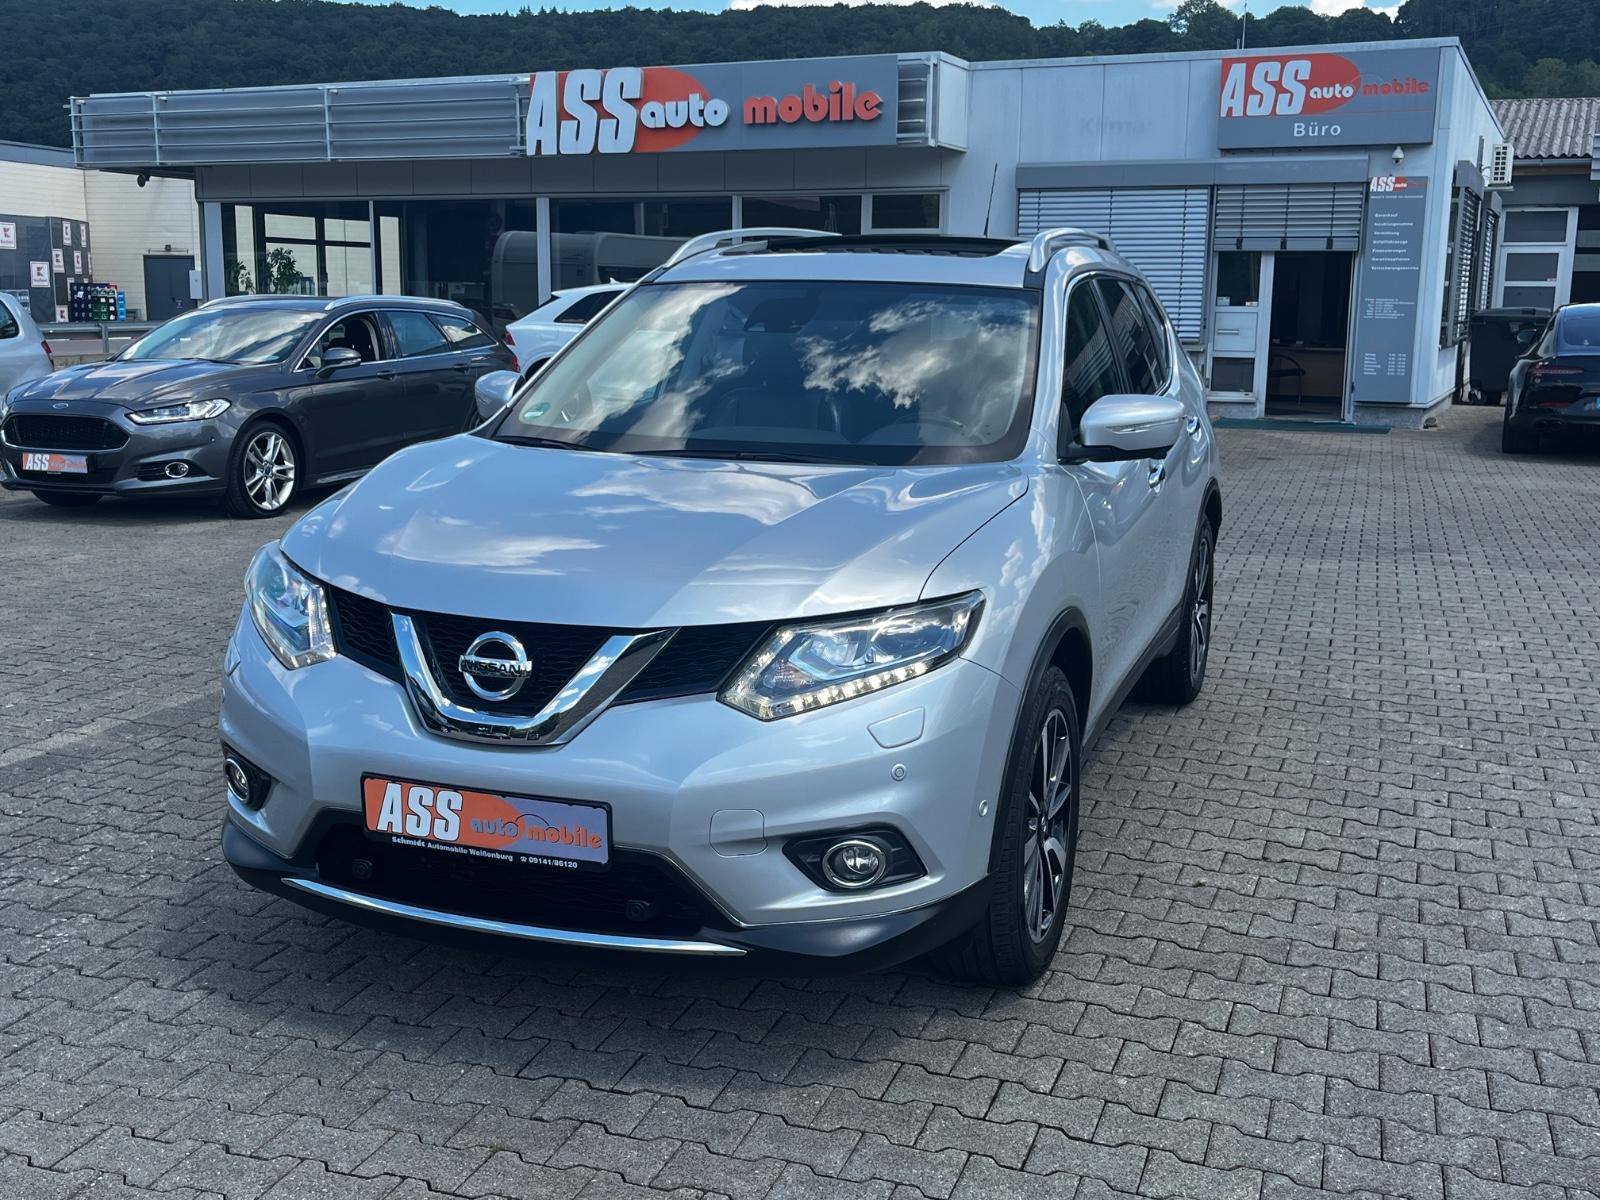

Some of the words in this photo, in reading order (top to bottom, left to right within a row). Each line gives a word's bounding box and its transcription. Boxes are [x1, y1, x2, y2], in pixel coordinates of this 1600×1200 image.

[1221, 60, 1311, 117] ASS
[1309, 83, 1355, 99] auto
[1363, 77, 1429, 96] mobile
[526, 67, 643, 156] ASS
[640, 93, 730, 128] auto
[743, 80, 884, 126] mobile
[1293, 122, 1342, 137] Büro
[1370, 176, 1395, 192] ASS
[26, 453, 49, 470] ASS
[463, 660, 521, 677] NISSAN
[377, 781, 463, 841] ASS
[469, 817, 519, 837] auto
[528, 824, 602, 849] mobile
[391, 836, 425, 848] Schmidt
[427, 842, 468, 854] Automobile
[469, 849, 513, 862] Weißenburg
[529, 857, 577, 868] 09141/86120
